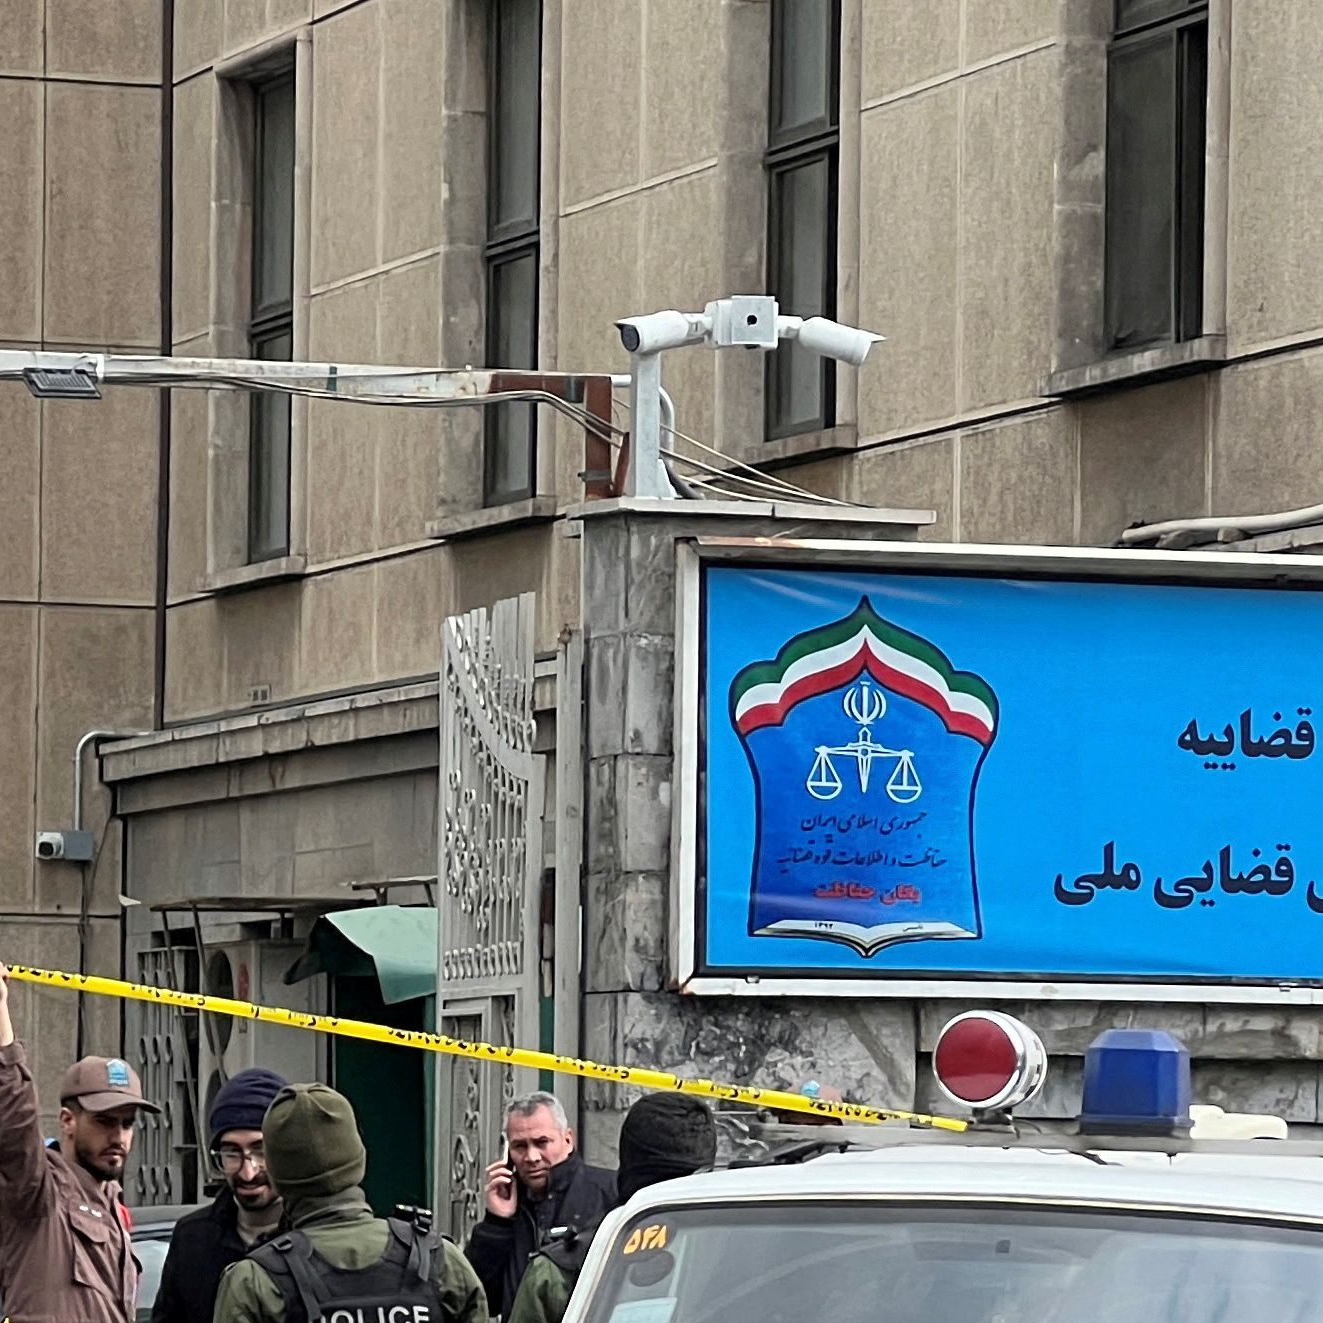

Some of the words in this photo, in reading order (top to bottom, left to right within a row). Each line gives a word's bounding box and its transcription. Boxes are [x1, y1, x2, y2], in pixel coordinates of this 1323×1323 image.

[1177, 706, 1317, 772] قضاییه
[1052, 839, 1142, 906] ملی
[1153, 843, 1295, 910] قضایی
